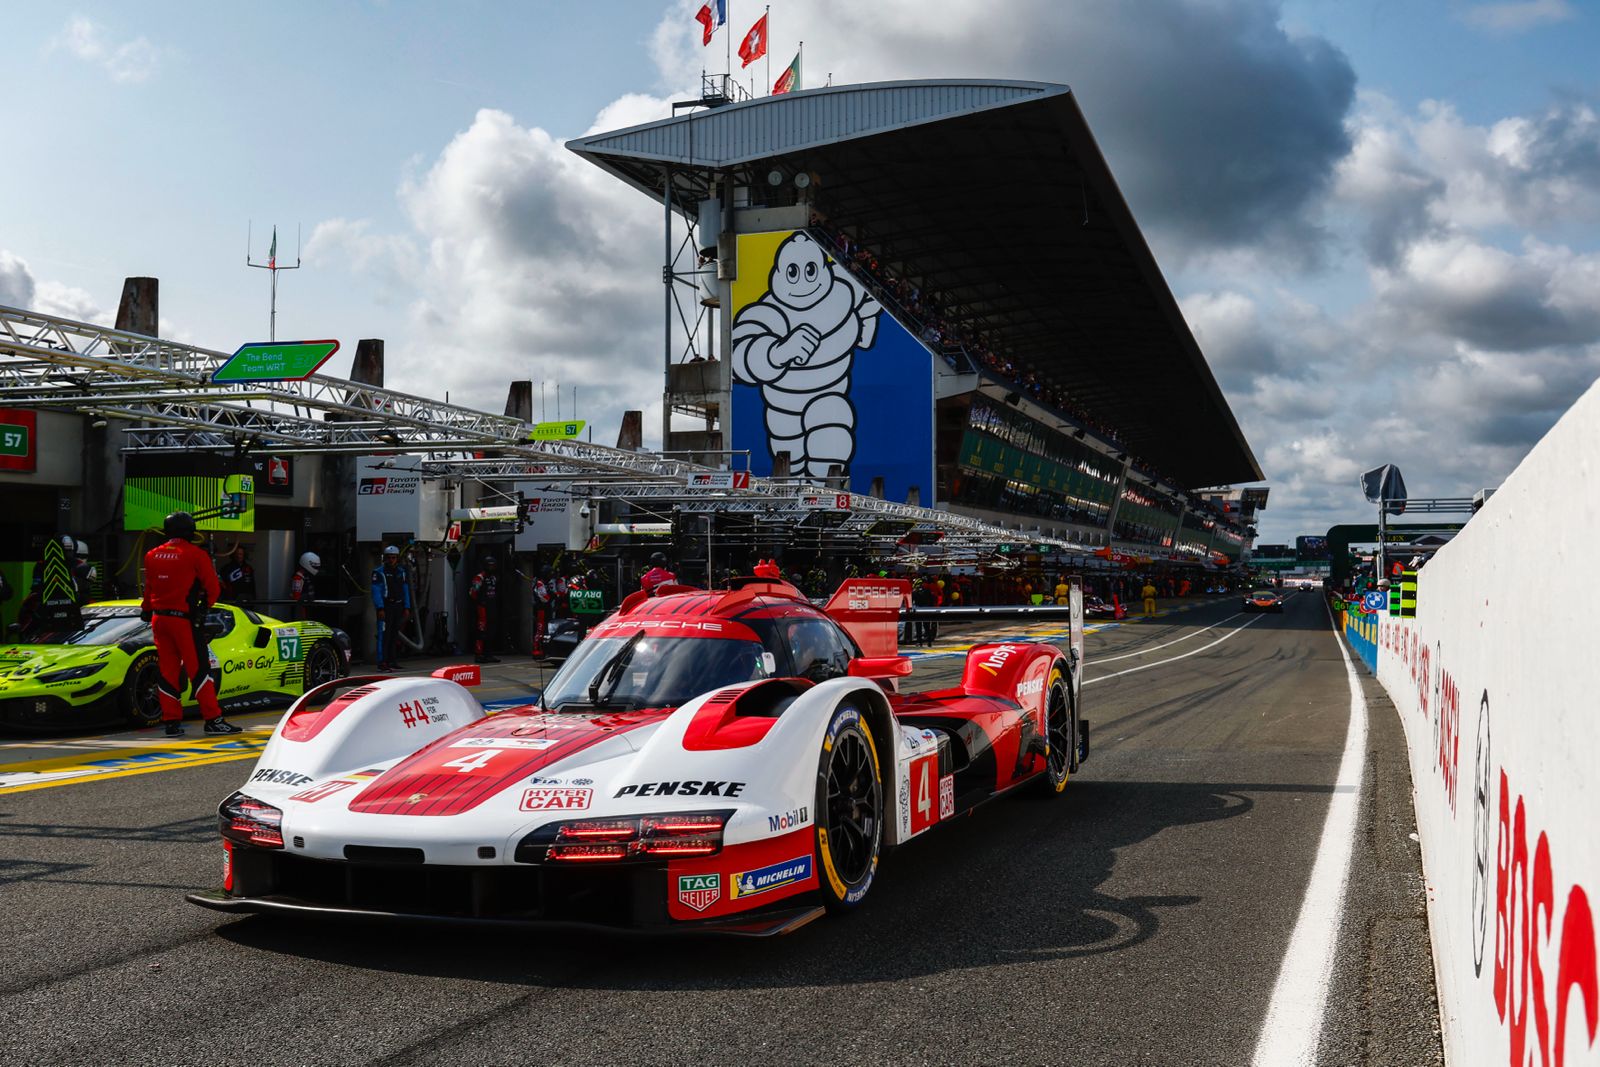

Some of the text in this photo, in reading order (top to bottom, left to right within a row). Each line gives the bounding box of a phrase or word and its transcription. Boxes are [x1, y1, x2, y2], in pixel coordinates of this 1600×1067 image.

[262, 353, 283, 361] Bend
[266, 363, 287, 372] WRT
[566, 426, 576, 434] 57
[5, 433, 22, 447] 57
[242, 481, 251, 491] 57
[735, 473, 746, 487] 7
[360, 484, 385, 494] GR
[838, 496, 847, 508] 8
[848, 586, 900, 598] PORSCHE
[848, 600, 869, 610] 963
[281, 638, 298, 659] 57
[1016, 678, 1044, 698] PENSKE
[421, 696, 440, 706] RACING
[399, 699, 430, 729] #4
[426, 705, 437, 714] FOR
[441, 749, 505, 773] 4
[250, 768, 314, 787] PENSKE
[528, 789, 587, 797] HYPER
[612, 780, 747, 799] PENSKE
[917, 761, 932, 822] 4
[525, 796, 588, 809] CAR
[767, 809, 799, 832] Mobil
[757, 864, 806, 887] MICHELIN
[682, 876, 717, 889] TAG
[681, 889, 718, 909] HEUER
